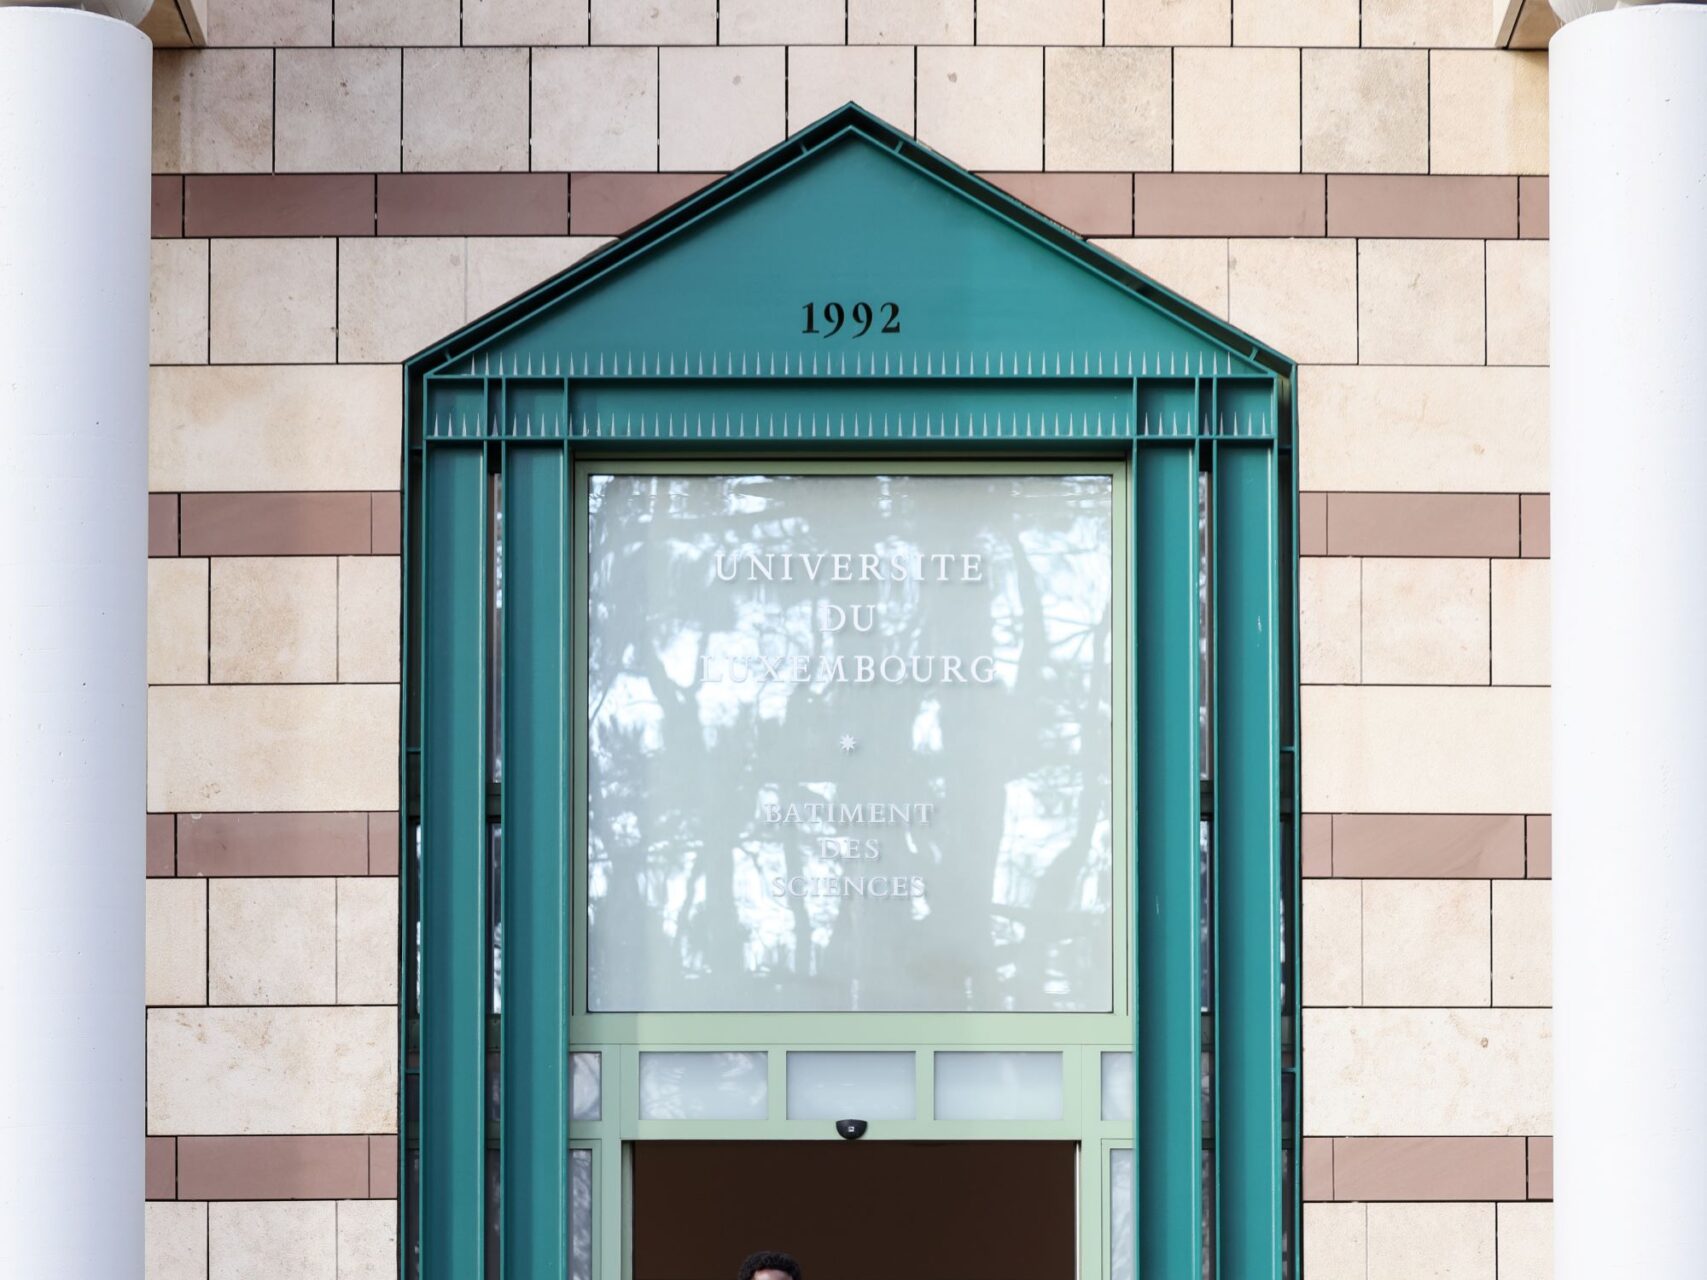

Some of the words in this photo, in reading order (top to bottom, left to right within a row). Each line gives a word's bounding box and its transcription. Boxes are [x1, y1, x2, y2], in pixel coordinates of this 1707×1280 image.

[801, 302, 900, 339] 1992
[714, 553, 983, 582] UNIVERSITE
[819, 604, 876, 632] DU
[701, 655, 995, 683] LUXEMBOURG
[764, 803, 934, 823] BATIMENT
[818, 838, 880, 859] DES
[772, 876, 926, 897] SCIENCES
